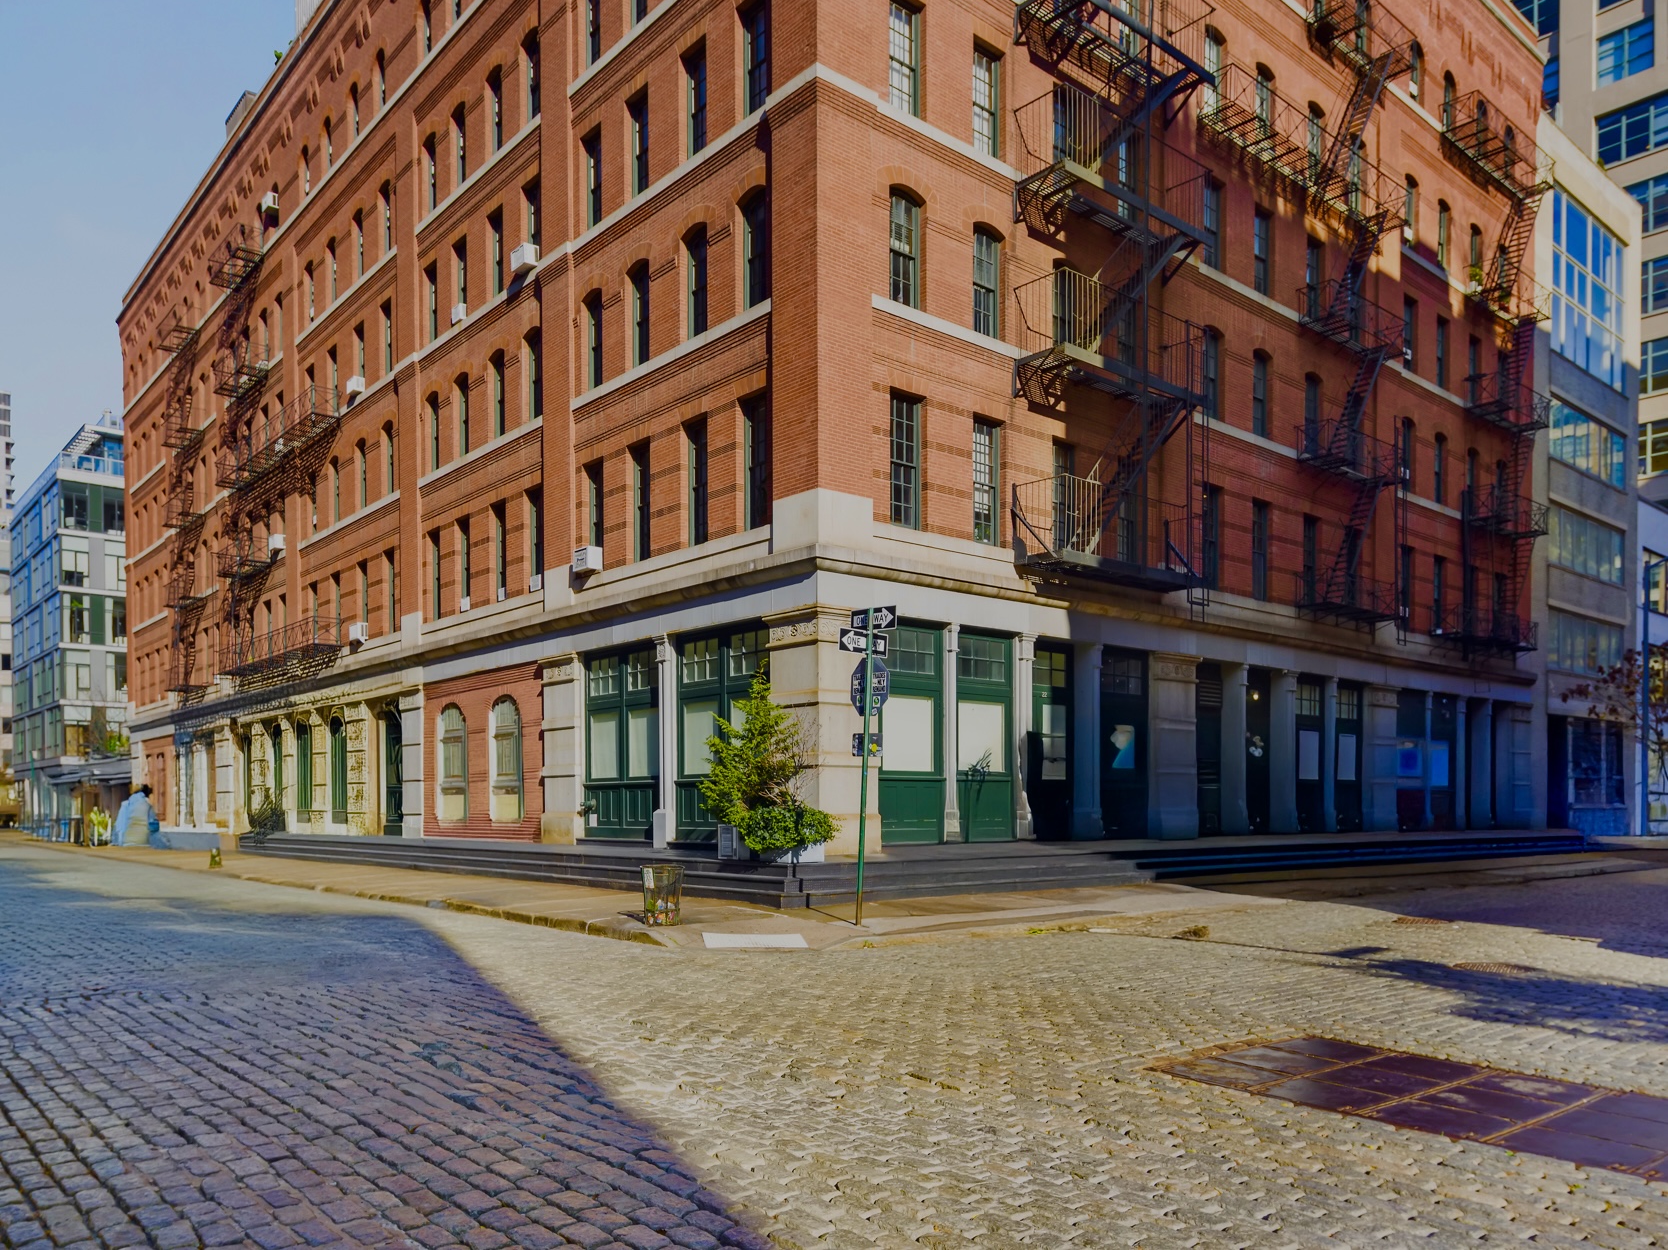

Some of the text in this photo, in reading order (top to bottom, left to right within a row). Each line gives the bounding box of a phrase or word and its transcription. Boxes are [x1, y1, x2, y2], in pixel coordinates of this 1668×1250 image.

[857, 612, 888, 625] ONE WAY
[847, 636, 861, 647] ONE
